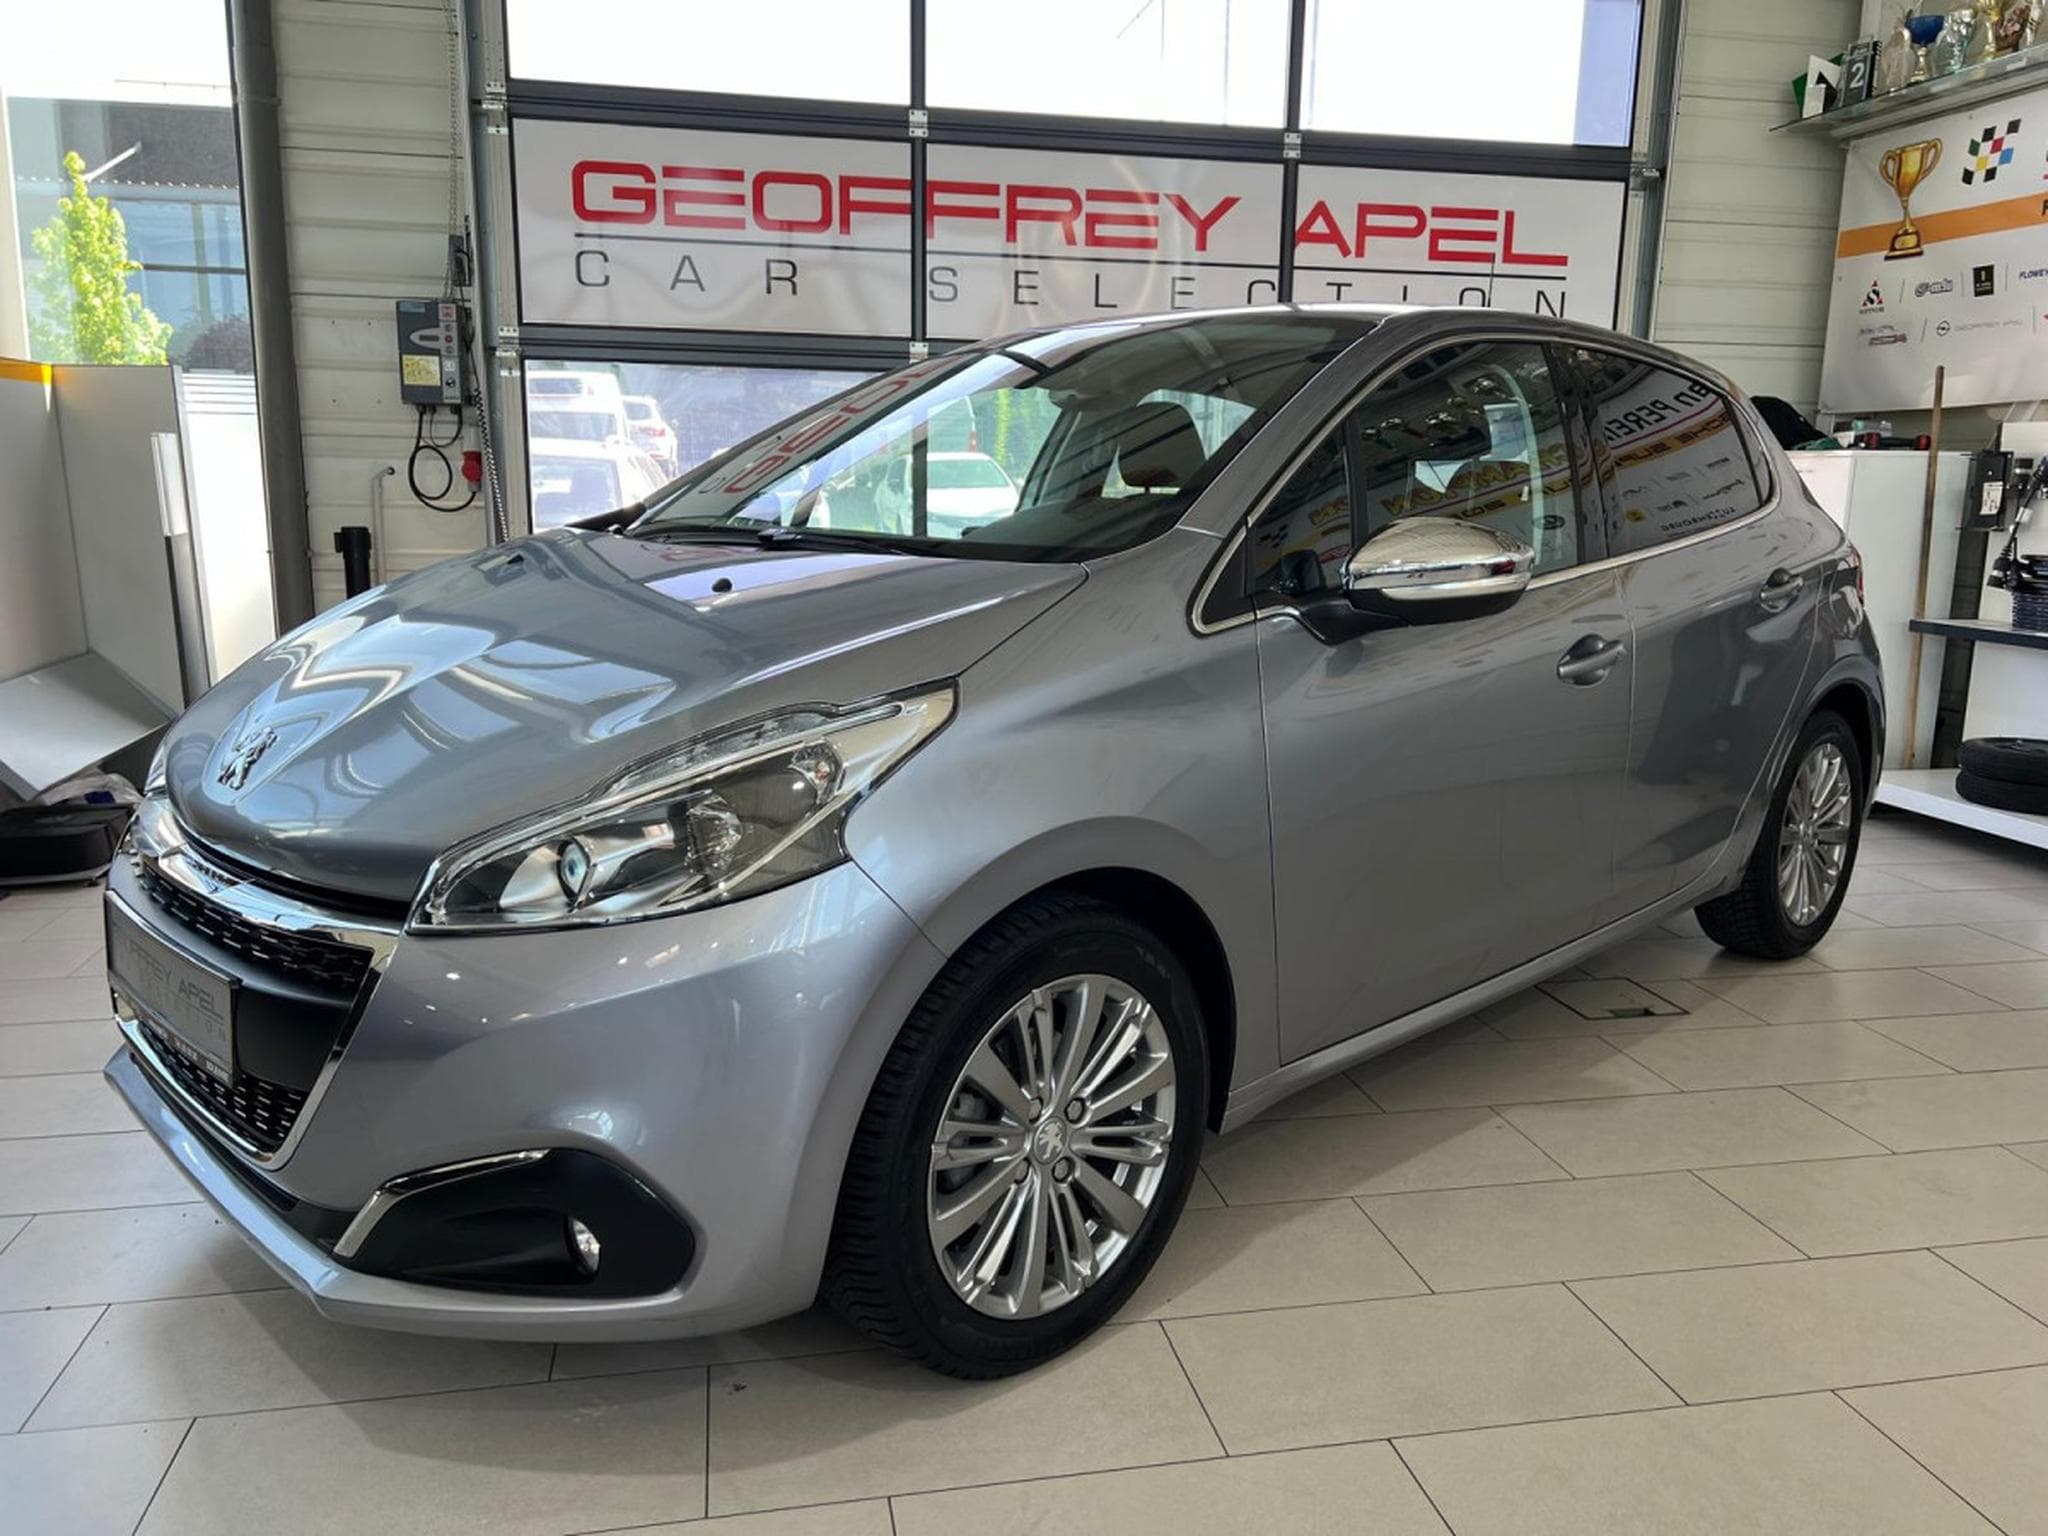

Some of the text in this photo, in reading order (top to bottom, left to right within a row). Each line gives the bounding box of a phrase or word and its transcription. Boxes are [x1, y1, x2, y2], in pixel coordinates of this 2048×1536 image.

[1850, 62, 1865, 89] 2
[571, 159, 1569, 267] GEOFFREY APEL
[575, 249, 798, 296] CAR
